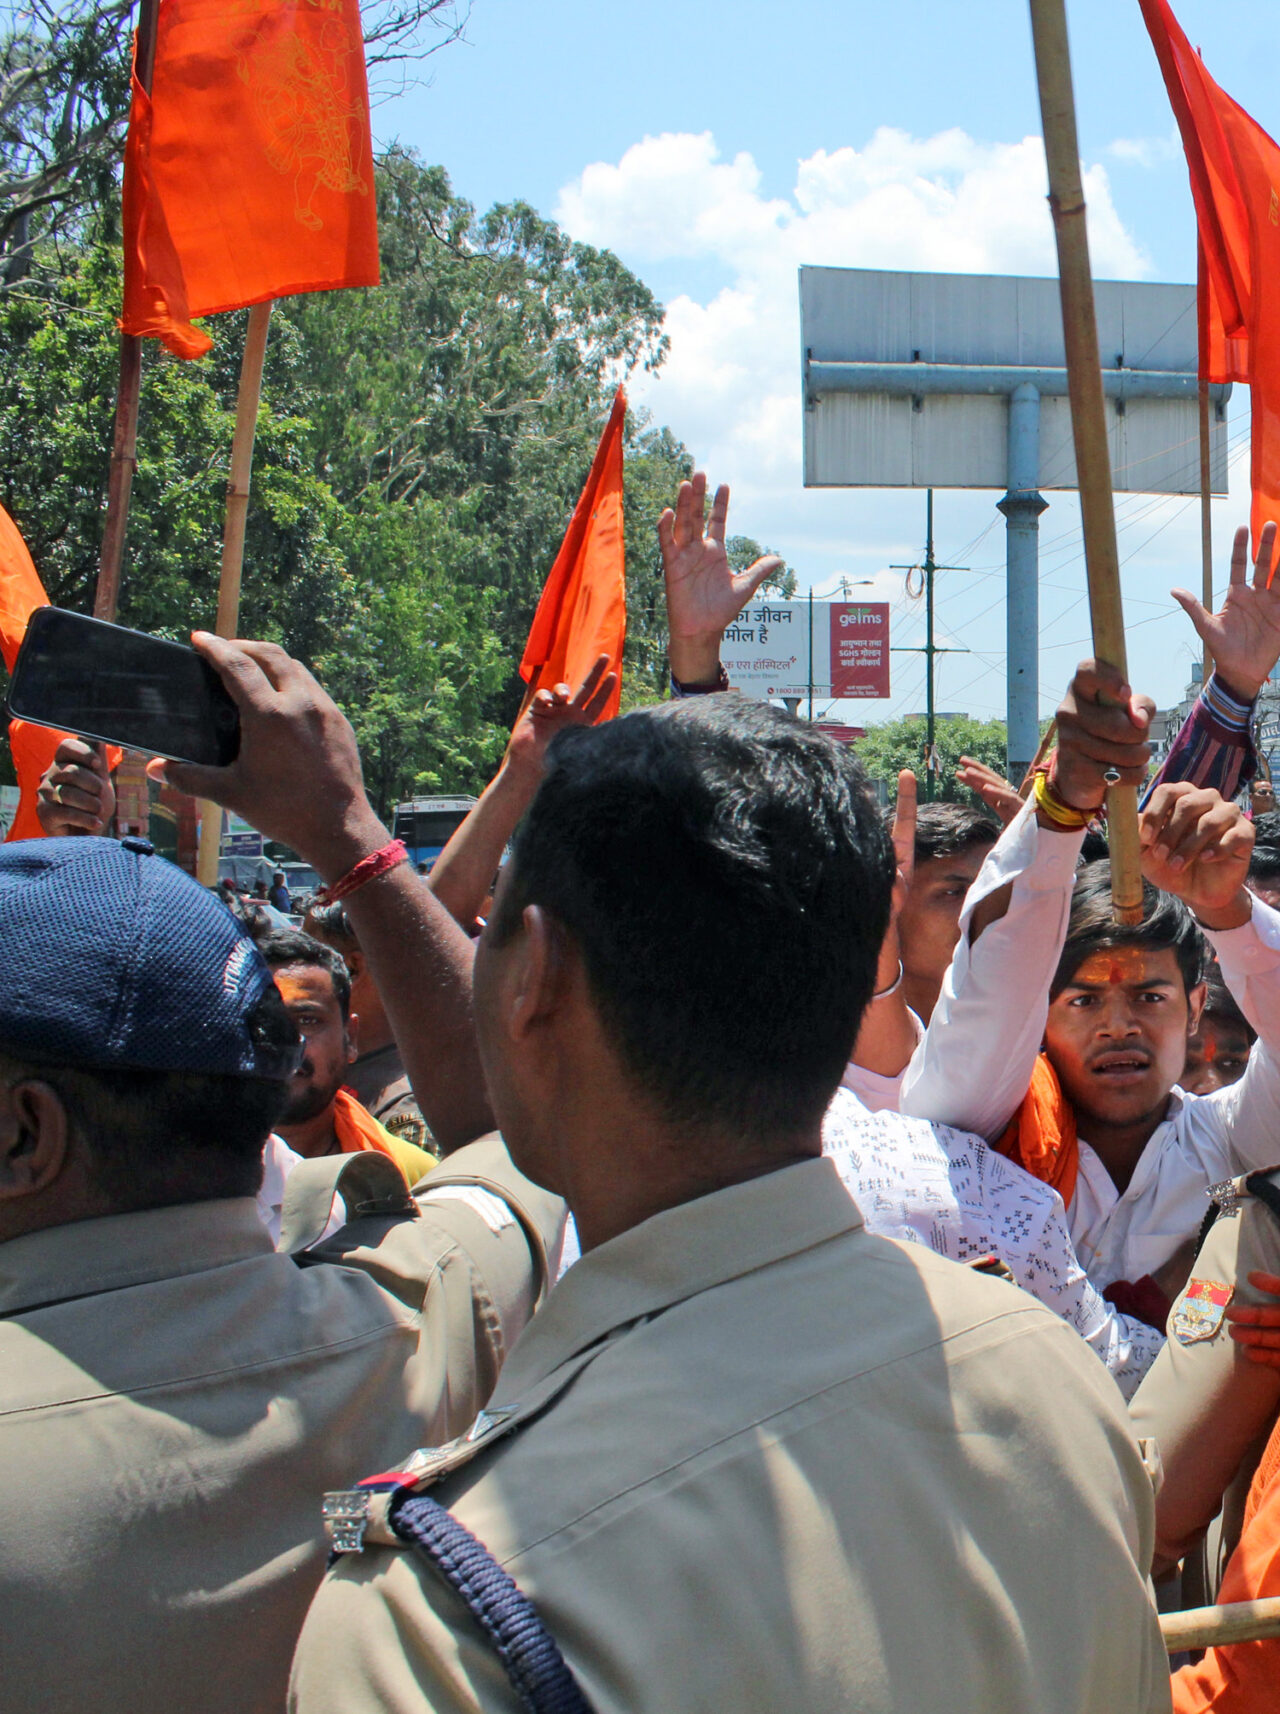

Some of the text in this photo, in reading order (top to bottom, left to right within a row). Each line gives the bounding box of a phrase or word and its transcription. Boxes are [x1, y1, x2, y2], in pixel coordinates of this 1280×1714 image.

[753, 606, 792, 623] जीवन
[758, 624, 768, 644] है
[753, 658, 790, 670] हॉस्पिटल
